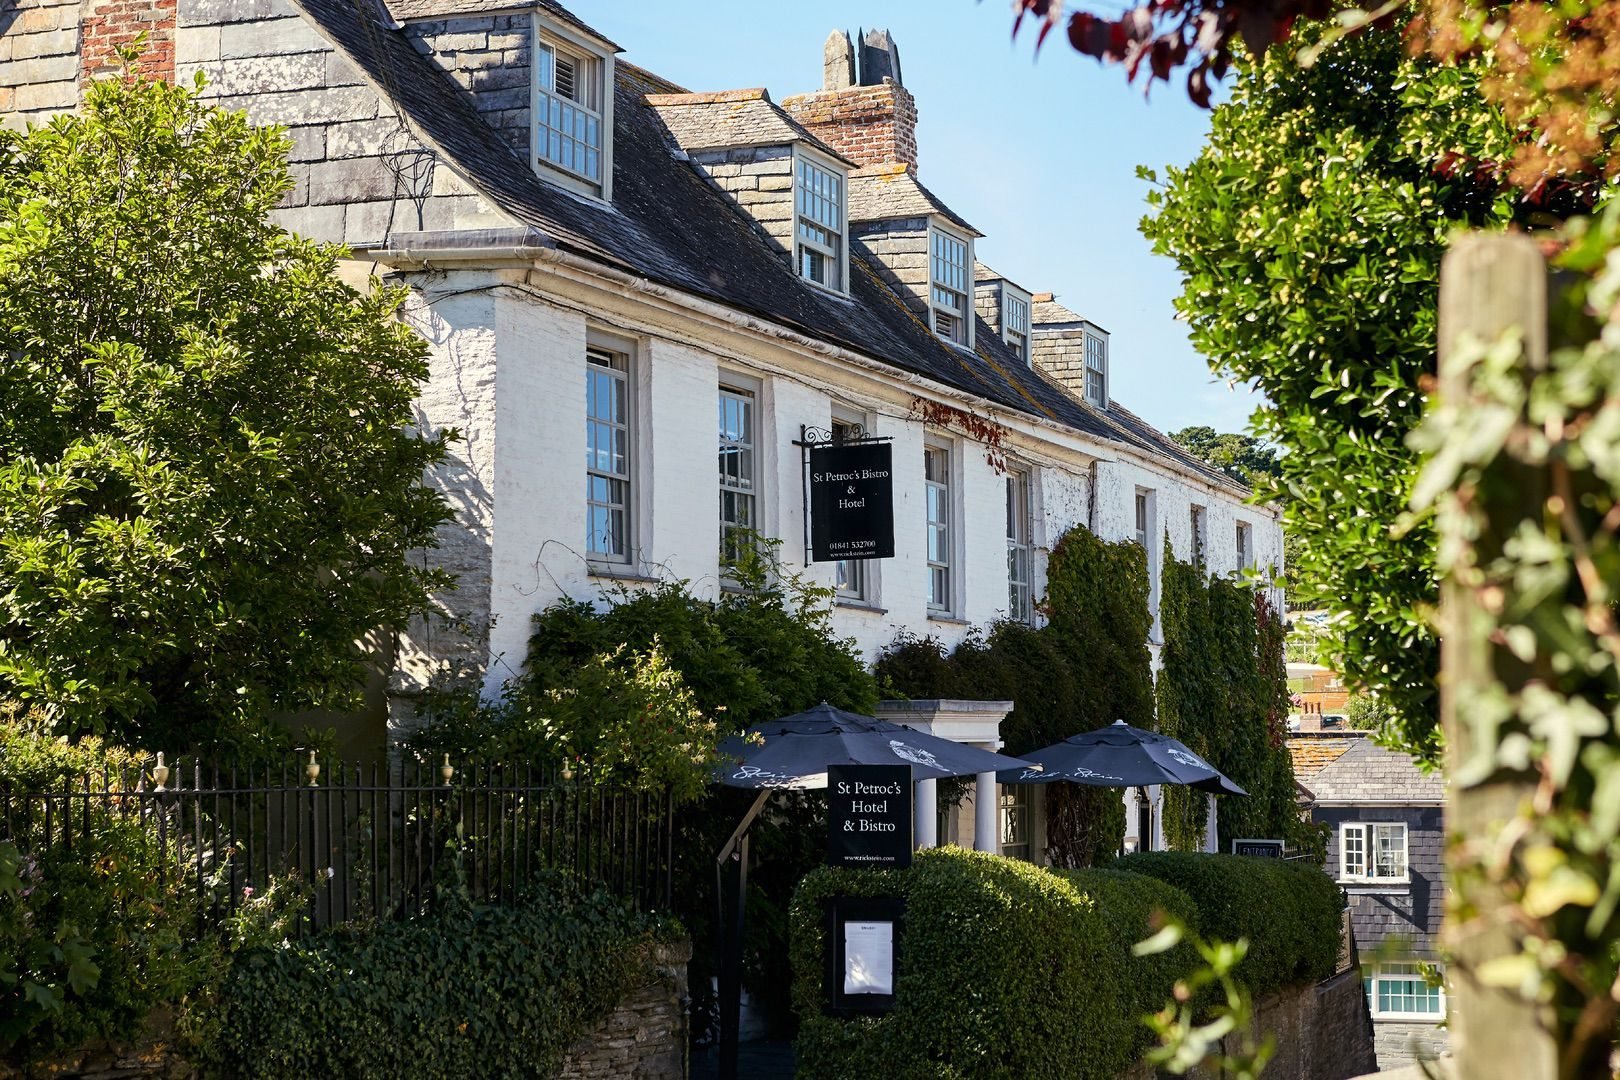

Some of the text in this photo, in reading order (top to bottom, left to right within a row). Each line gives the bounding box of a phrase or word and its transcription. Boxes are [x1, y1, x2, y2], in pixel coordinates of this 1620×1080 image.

[813, 469, 888, 483] St Petroc's Bistro
[847, 485, 856, 494] &
[839, 497, 865, 509] Hotel
[829, 540, 876, 550] 01841 532700
[837, 781, 901, 795] St Petroc's
[851, 800, 888, 813] Hotel
[843, 818, 896, 832] & Bistro
[843, 854, 895, 862] www.rickstein.com
